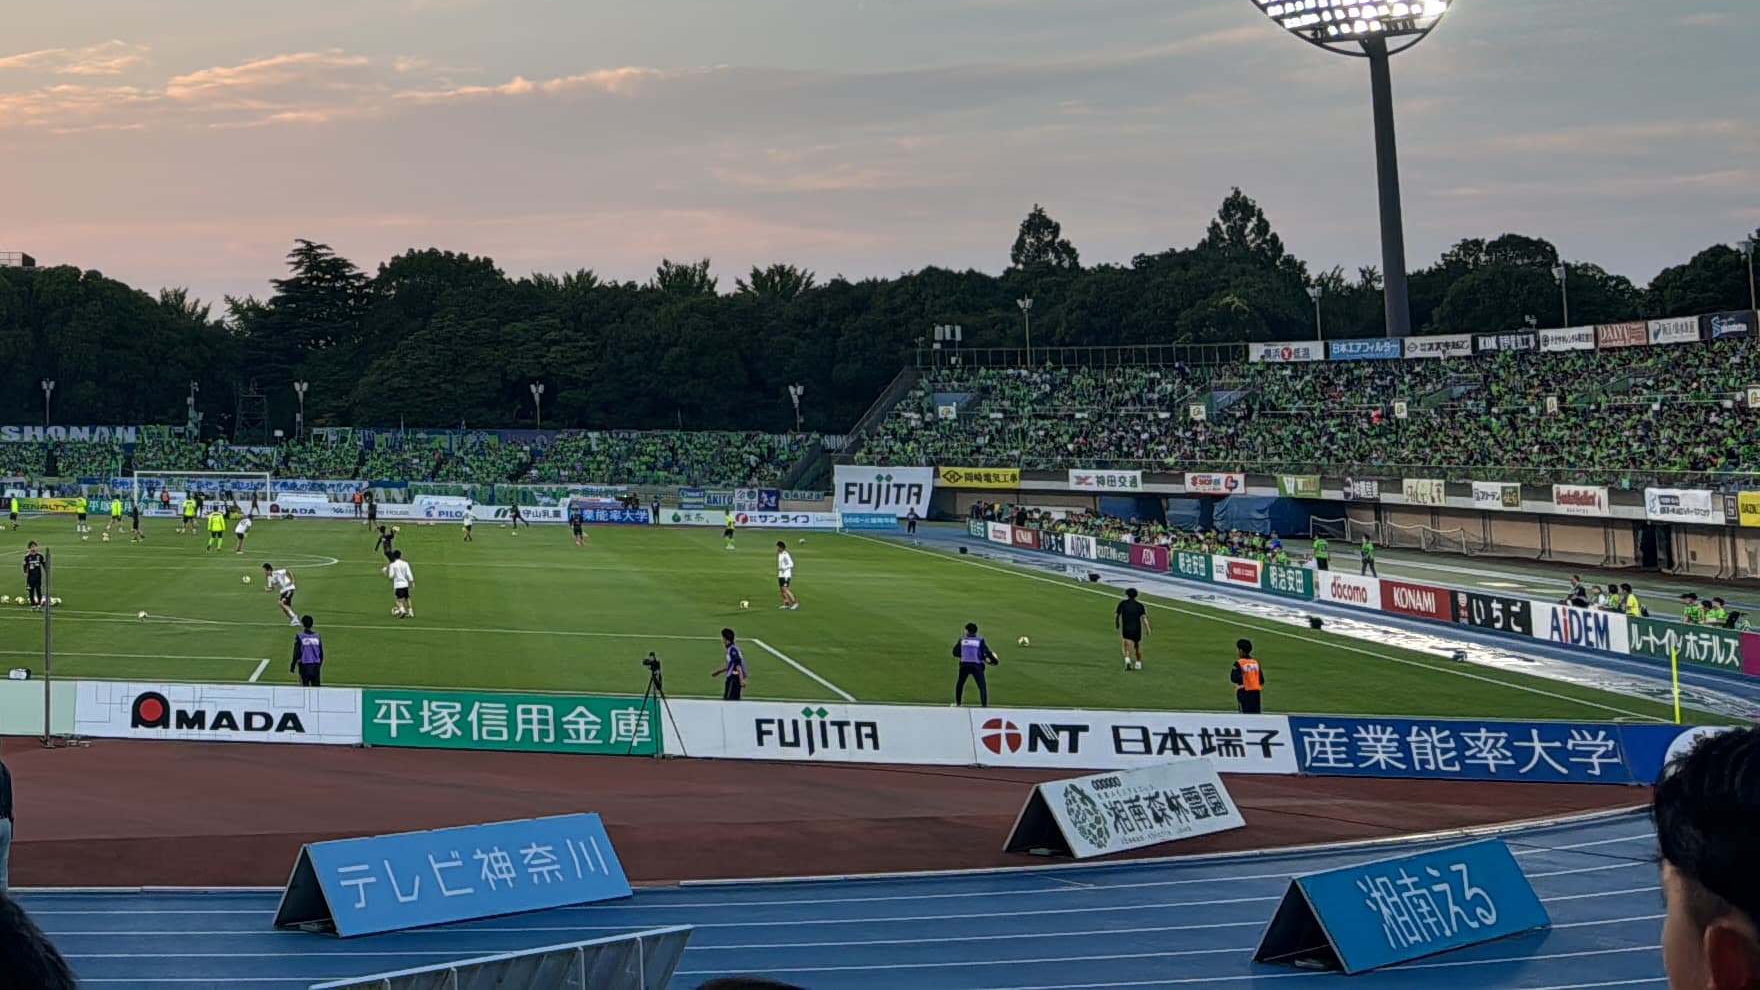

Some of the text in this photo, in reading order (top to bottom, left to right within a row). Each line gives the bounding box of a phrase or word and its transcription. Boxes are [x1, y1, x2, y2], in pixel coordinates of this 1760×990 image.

[438, 509, 463, 518] PILO
[1269, 565, 1304, 594] 明治安田
[1330, 576, 1368, 604] docomo
[1392, 586, 1436, 614] KONAMI
[1472, 597, 1523, 632] いちご
[372, 698, 652, 746] 平塚信用金庫
[1028, 724, 1286, 760] NT 日本端子
[1299, 722, 1624, 777] 産業能率大学
[337, 835, 611, 909] テレビ神奈川
[1356, 862, 1498, 949] 湘南える
